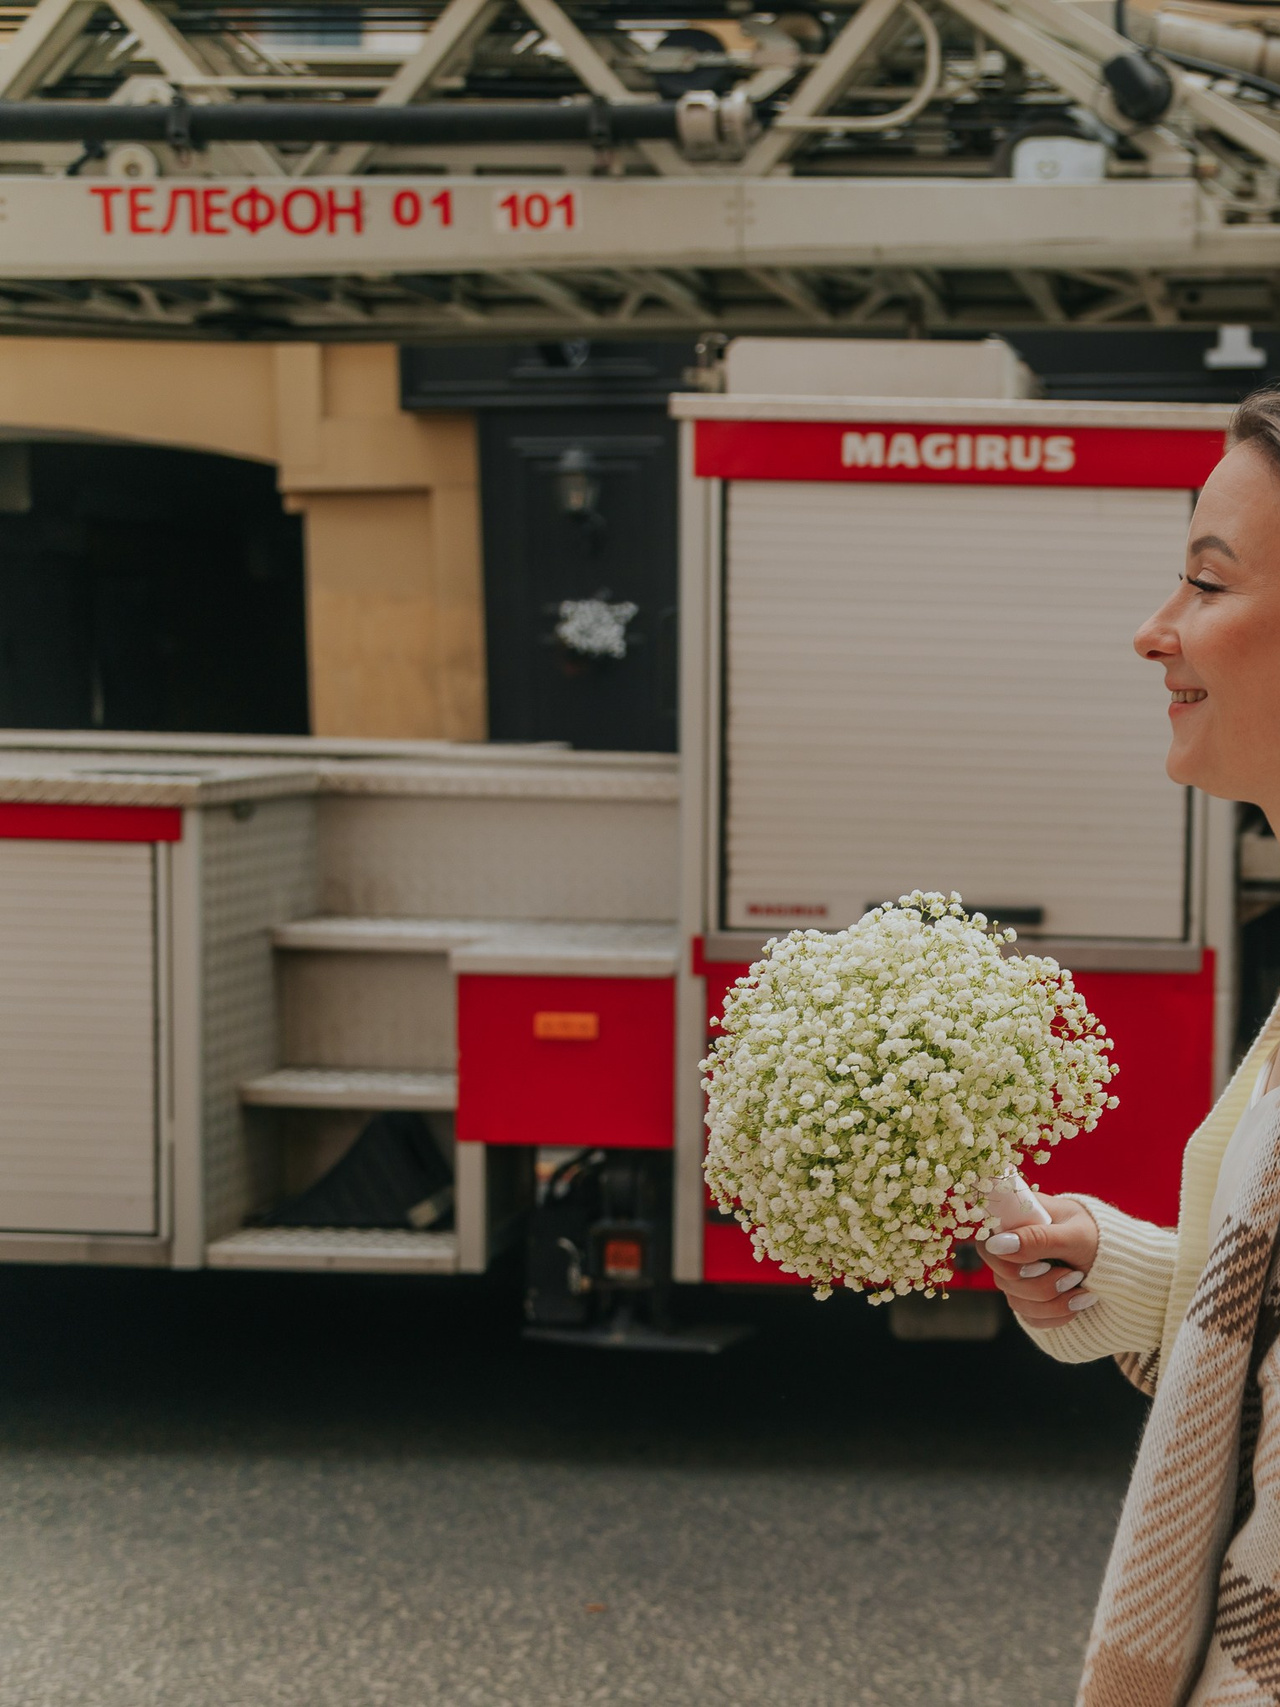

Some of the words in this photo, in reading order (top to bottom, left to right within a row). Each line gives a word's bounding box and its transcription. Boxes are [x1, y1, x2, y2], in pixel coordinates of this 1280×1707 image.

[89, 186, 364, 235] ТЕЛЕФОН
[392, 189, 452, 227] 01
[499, 193, 575, 229] 101
[841, 431, 1075, 472] MAGIRUS
